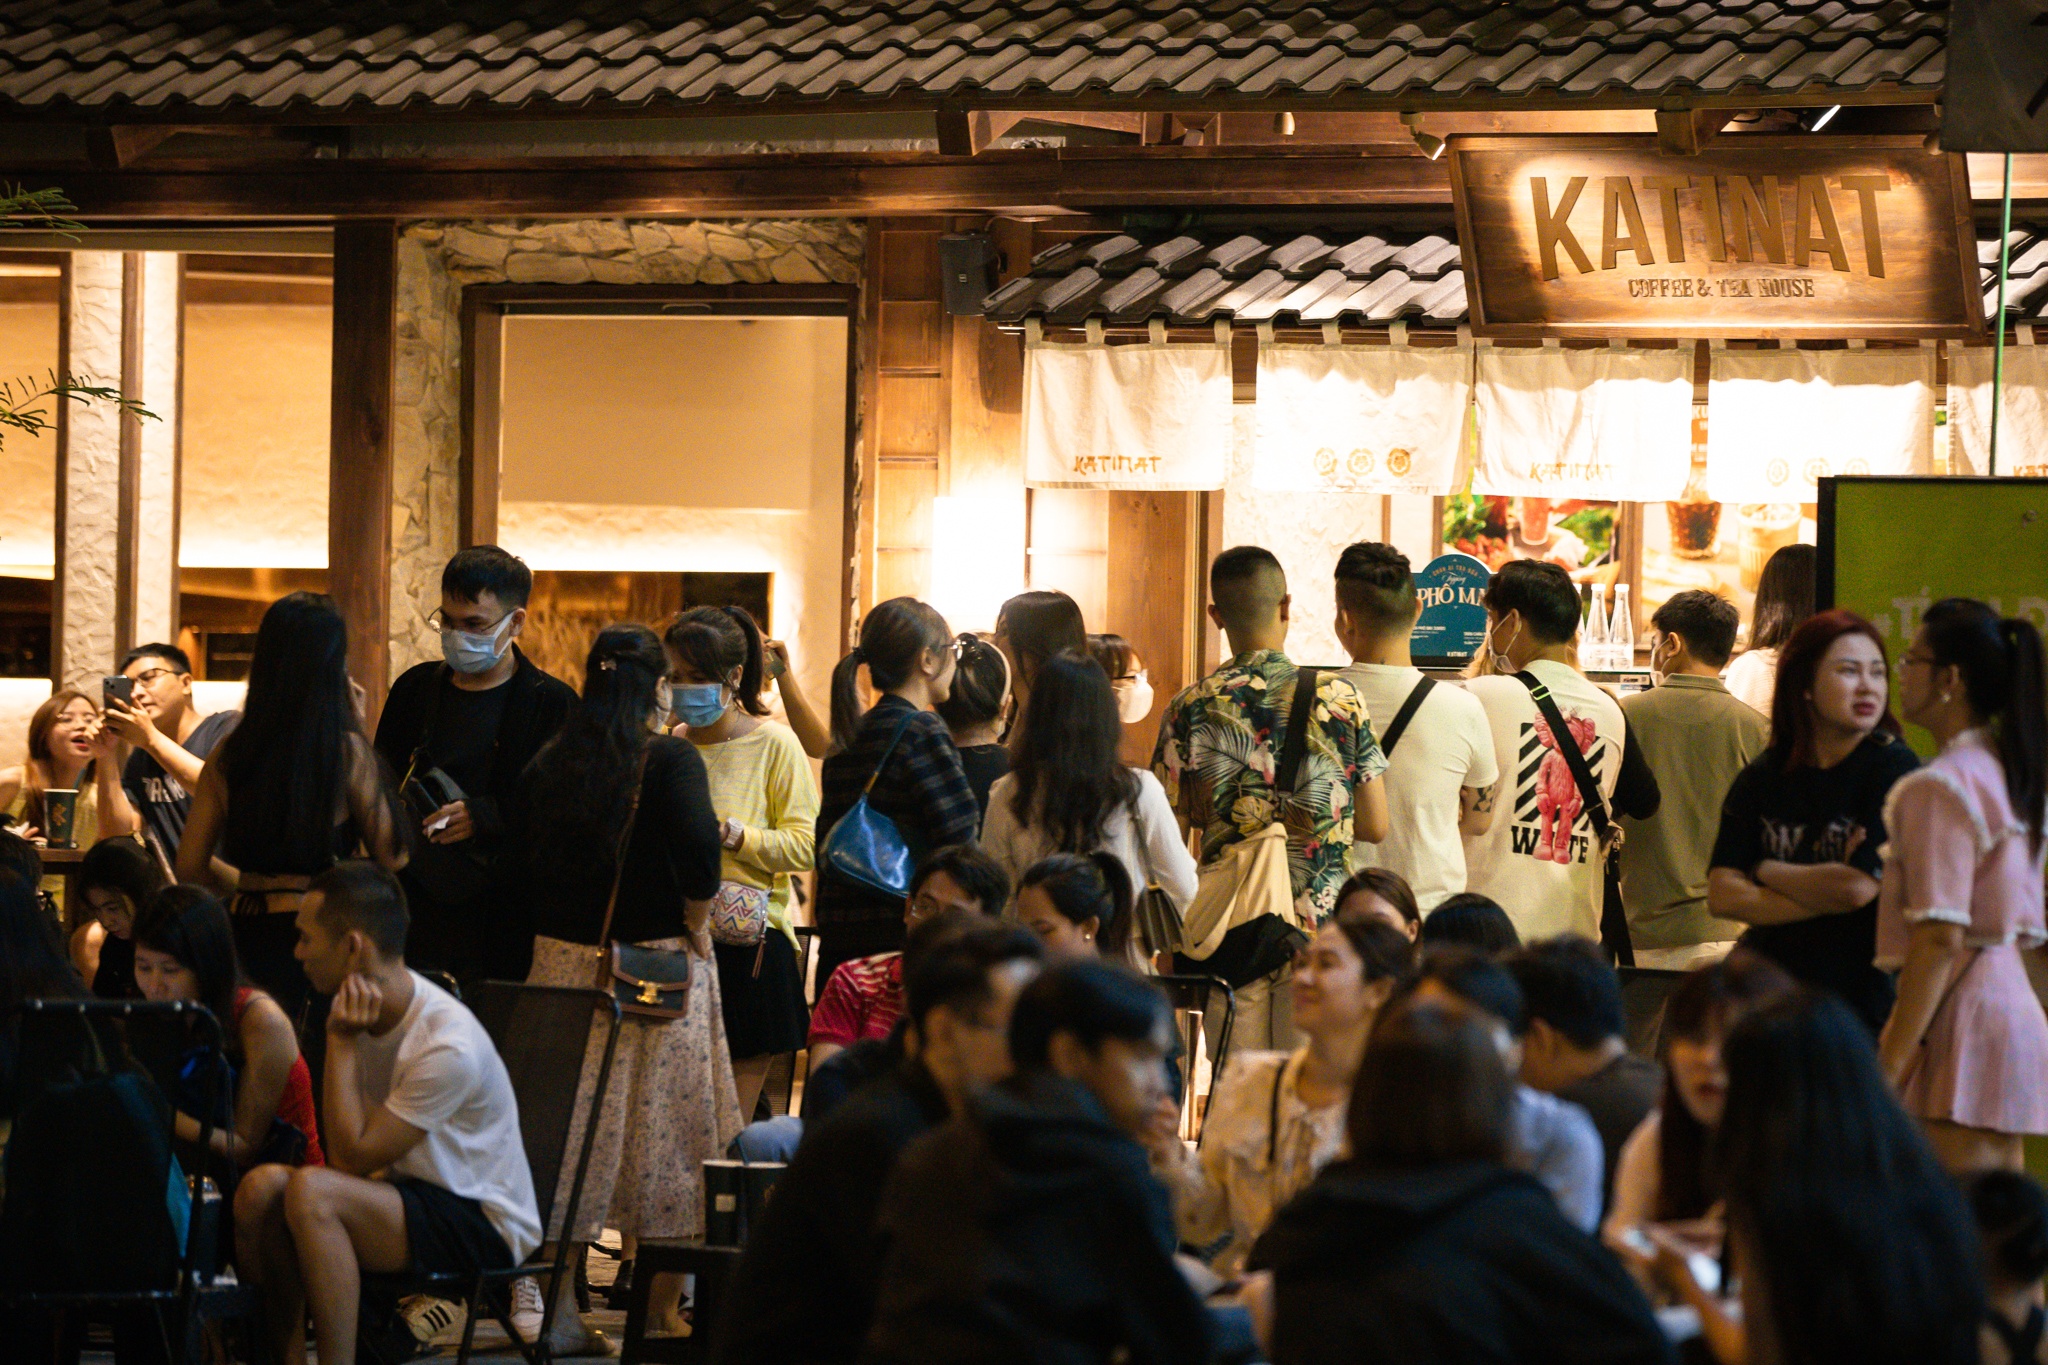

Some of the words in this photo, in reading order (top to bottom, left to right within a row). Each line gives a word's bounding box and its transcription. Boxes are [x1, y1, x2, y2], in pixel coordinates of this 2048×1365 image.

[1529, 174, 1892, 281] KATINAT
[1628, 278, 1694, 298] COFFEE
[1697, 278, 1713, 297] &
[1716, 278, 1753, 298] TEA
[1757, 278, 1816, 298] HOUSE
[1073, 455, 1162, 476] KATINAT
[1416, 583, 1455, 608] PHÔ
